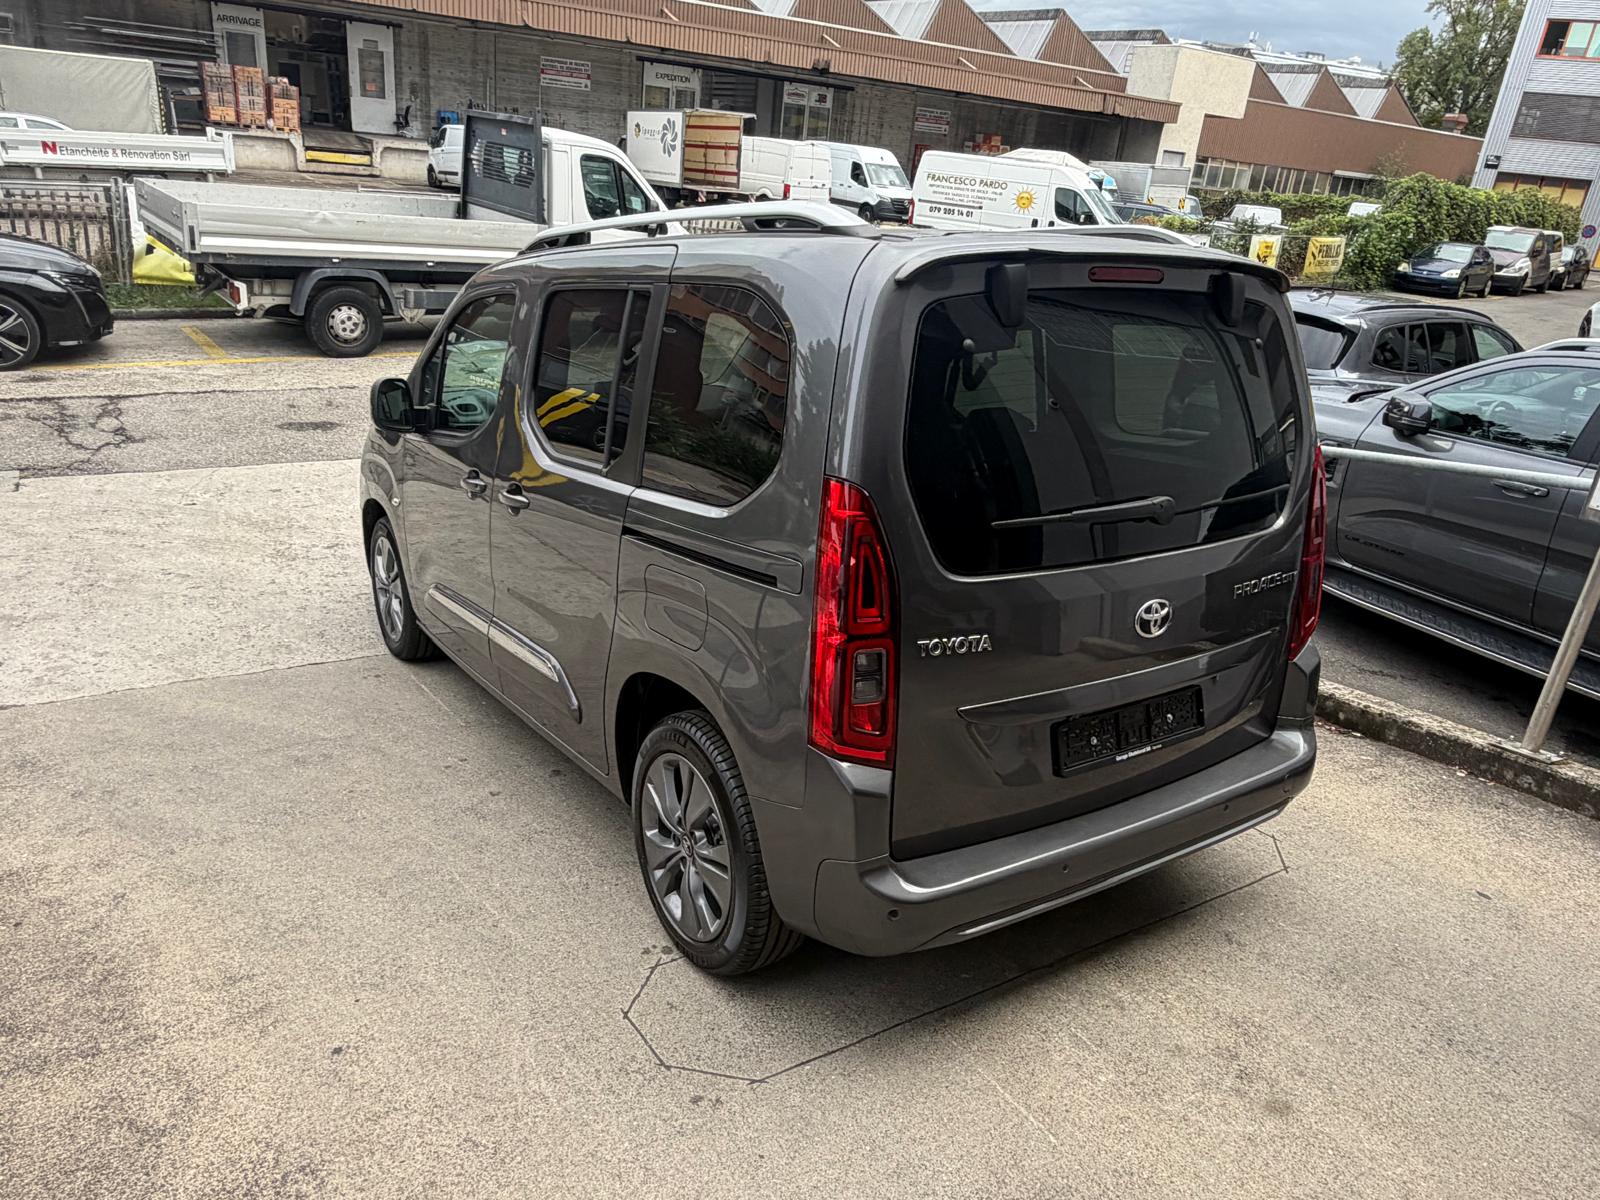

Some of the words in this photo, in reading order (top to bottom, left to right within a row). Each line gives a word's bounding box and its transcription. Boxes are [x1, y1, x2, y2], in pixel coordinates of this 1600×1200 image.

[217, 14, 262, 27] ARRIVAGE
[655, 72, 690, 83] EXPEDITION
[112, 148, 120, 158] &
[927, 173, 977, 187] FRANCESCO
[979, 179, 1008, 190] PARDO
[943, 208, 956, 216] 205
[965, 210, 974, 218] 01
[1233, 572, 1282, 599] PROACE
[917, 634, 993, 657] TOYOTA
